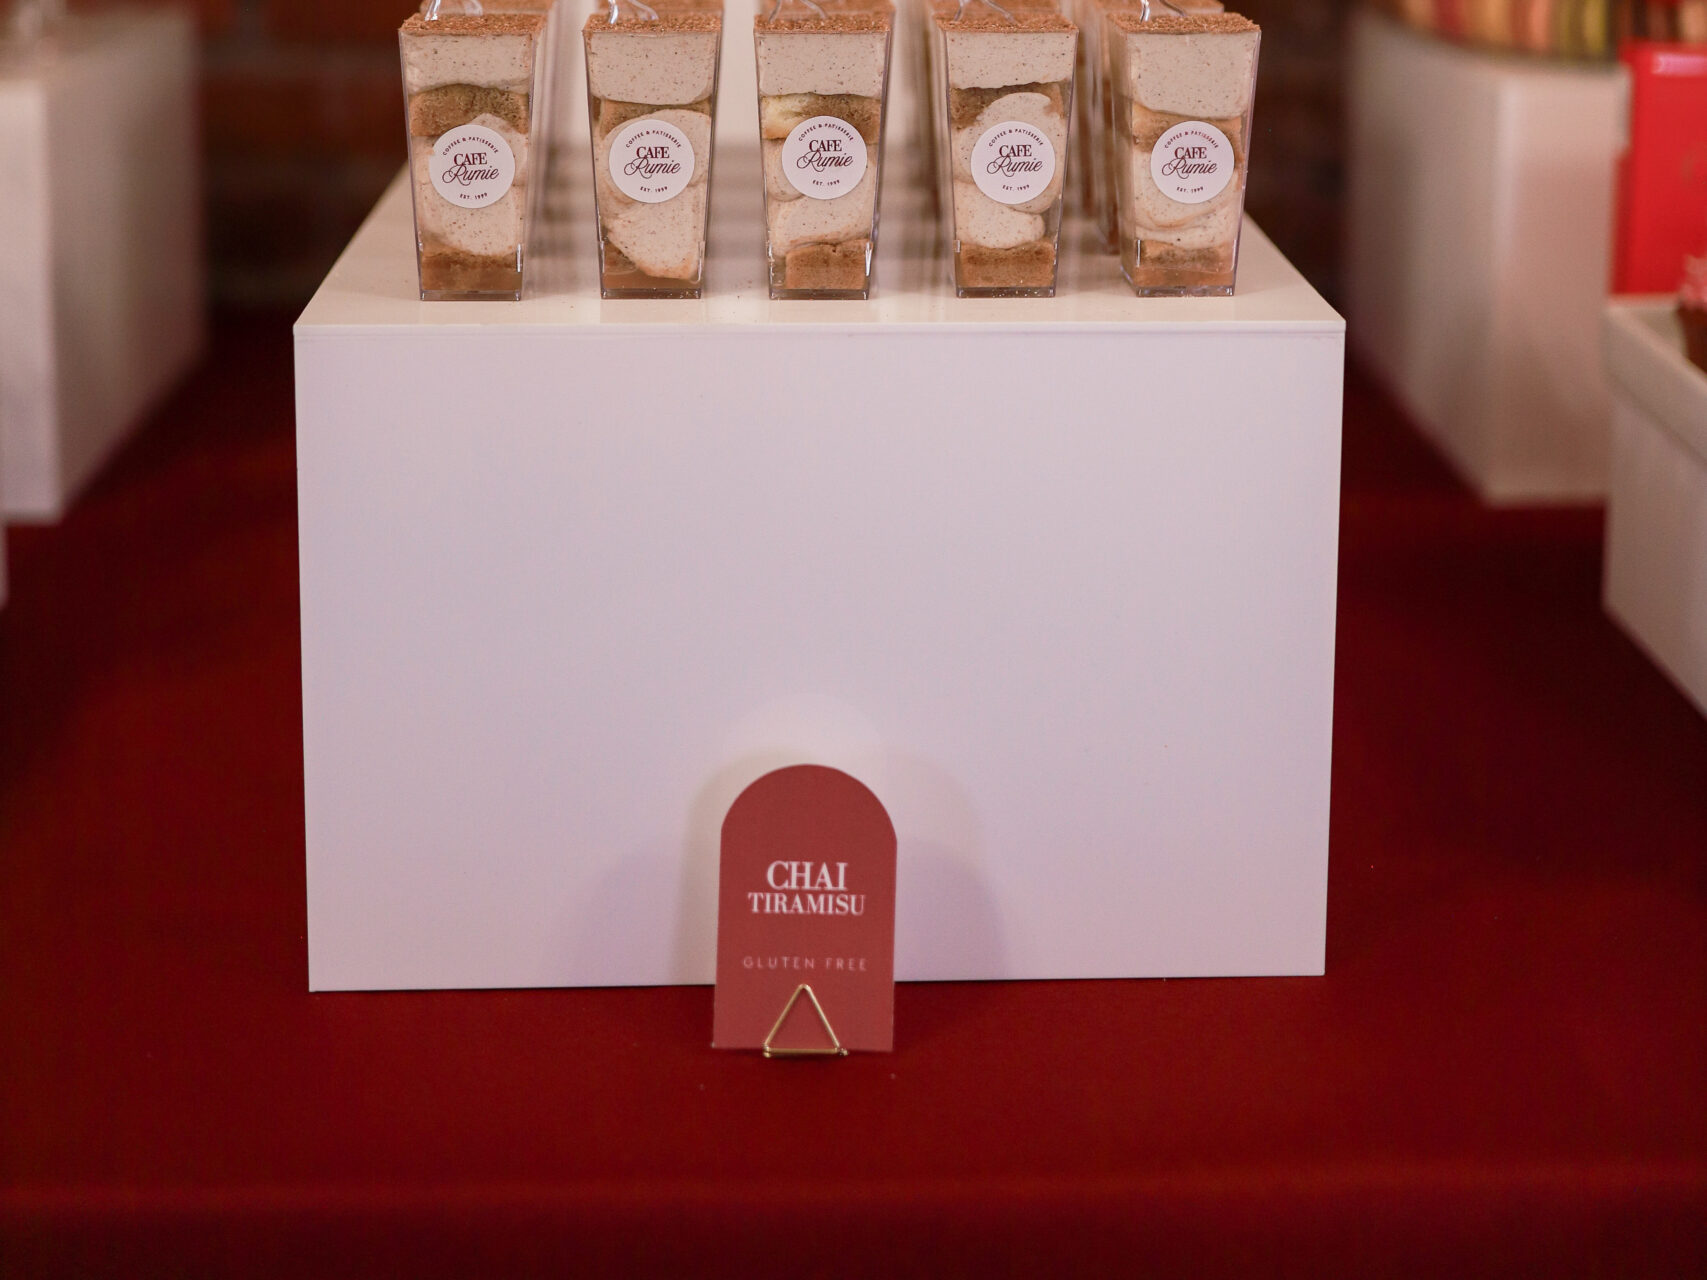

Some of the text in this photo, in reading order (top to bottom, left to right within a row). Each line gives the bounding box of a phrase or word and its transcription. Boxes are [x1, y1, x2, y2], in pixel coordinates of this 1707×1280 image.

[626, 132, 644, 148] COFFEE
[652, 130, 682, 148] PATISSERIE
[798, 125, 816, 142] COFFEE
[824, 124, 854, 141] PATISSERIE
[988, 130, 1006, 146] COFFEE
[1014, 128, 1044, 146] PATISSERIE
[1164, 133, 1182, 148] COFFEE
[1190, 130, 1218, 148] PATISSERIE
[442, 139, 460, 156] COFFEE
[468, 137, 498, 154] PATISSERIE
[636, 146, 670, 158] CAFE
[809, 140, 842, 152] CAFE
[999, 144, 1032, 158] CAFE
[1174, 146, 1207, 160] CAFE
[454, 152, 488, 166] CAFE
[624, 155, 681, 179] Rumie
[796, 148, 854, 172] Rumie
[986, 154, 1042, 178] Rumie
[1162, 156, 1218, 180] Rumie
[442, 162, 500, 186] Rumie
[766, 860, 848, 891] CHAI
[748, 892, 866, 916] TIRAMISU
[743, 956, 867, 971] GLUTEN FREE
